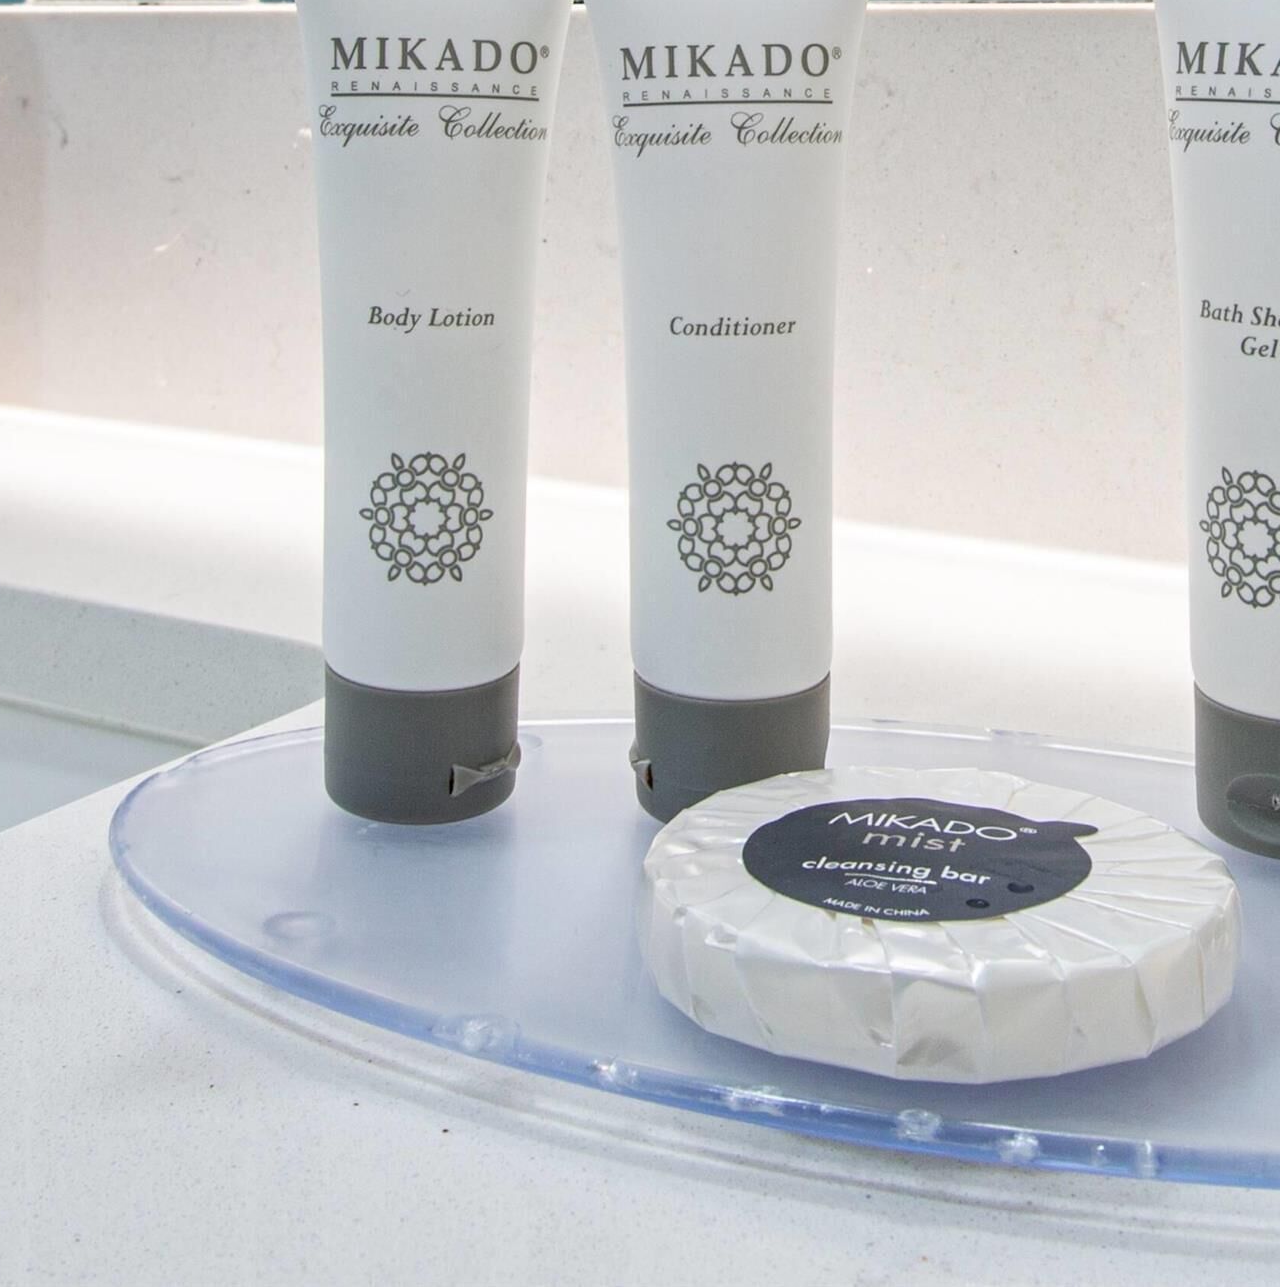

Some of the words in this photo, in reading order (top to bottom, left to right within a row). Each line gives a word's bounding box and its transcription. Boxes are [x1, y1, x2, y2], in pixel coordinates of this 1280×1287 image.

[331, 81, 538, 96] RENAISSANCE
[622, 88, 831, 102] RENAISSANCE
[318, 104, 420, 148] Exquisite
[438, 104, 548, 141] Collection
[612, 114, 713, 159] Exquisite
[730, 111, 843, 147] Collection
[1167, 108, 1251, 153] Exquisite
[368, 306, 422, 334] Body
[428, 307, 496, 327] Lotion
[1200, 299, 1244, 323] Bath
[670, 316, 797, 336] Conditioner
[1240, 336, 1279, 359] Gel
[862, 832, 967, 852] mist
[801, 856, 932, 880] cleansing
[940, 865, 992, 885] bar
[844, 878, 888, 891] ALOE
[891, 882, 928, 895] VERA
[822, 897, 862, 911] MADE
[863, 905, 881, 915] IN
[882, 907, 931, 917] CHINA
